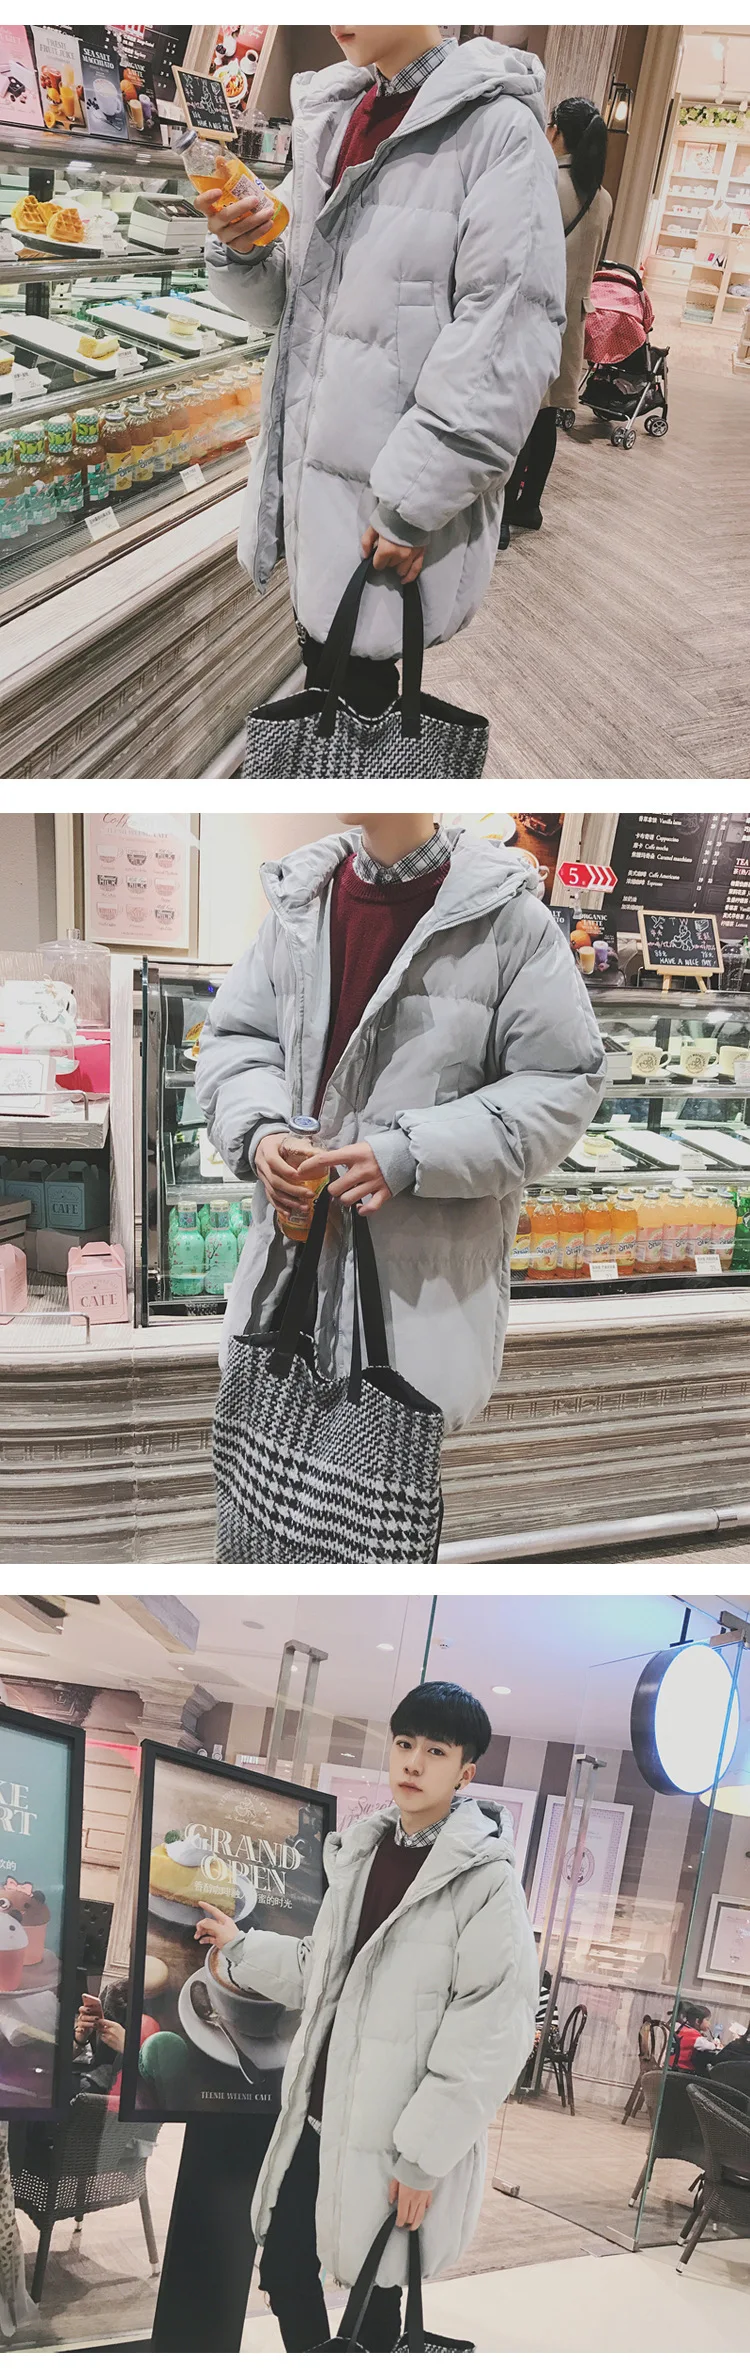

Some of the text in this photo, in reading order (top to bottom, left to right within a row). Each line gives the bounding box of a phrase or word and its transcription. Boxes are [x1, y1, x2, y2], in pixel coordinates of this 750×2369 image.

[83, 48, 111, 62] SEA SALT
[660, 957, 676, 965] HAVE
[52, 1203, 79, 1215] CAFE
[80, 1293, 118, 1308] CAFE
[184, 1823, 301, 1871] GRAND
[201, 1854, 286, 1895] OPEN
[201, 2090, 225, 2100] TEENIE
[254, 2093, 273, 2101] CAFE
